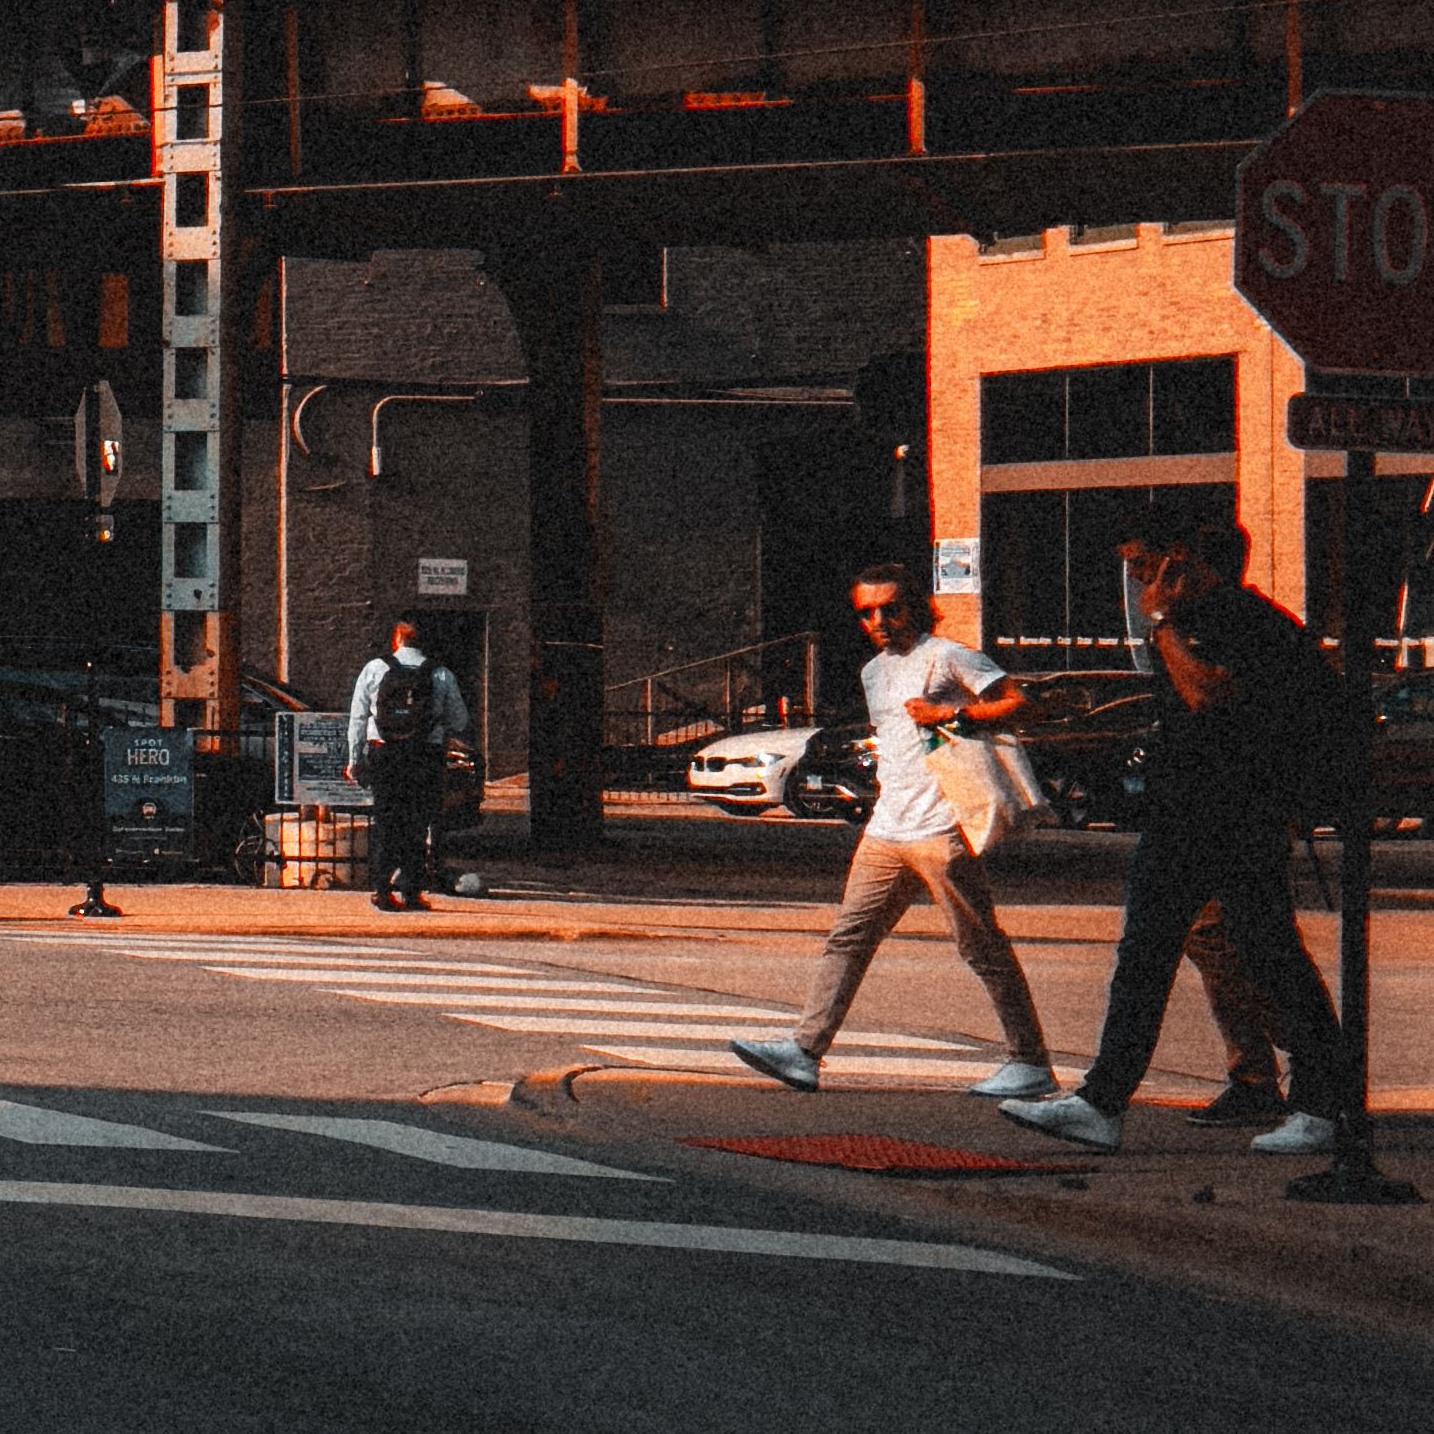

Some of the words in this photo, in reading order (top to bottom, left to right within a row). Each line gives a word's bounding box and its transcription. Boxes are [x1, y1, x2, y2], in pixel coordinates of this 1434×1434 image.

[1308, 404, 1368, 440] ALL
[133, 738, 163, 746] SPOT
[127, 748, 171, 766] HERO
